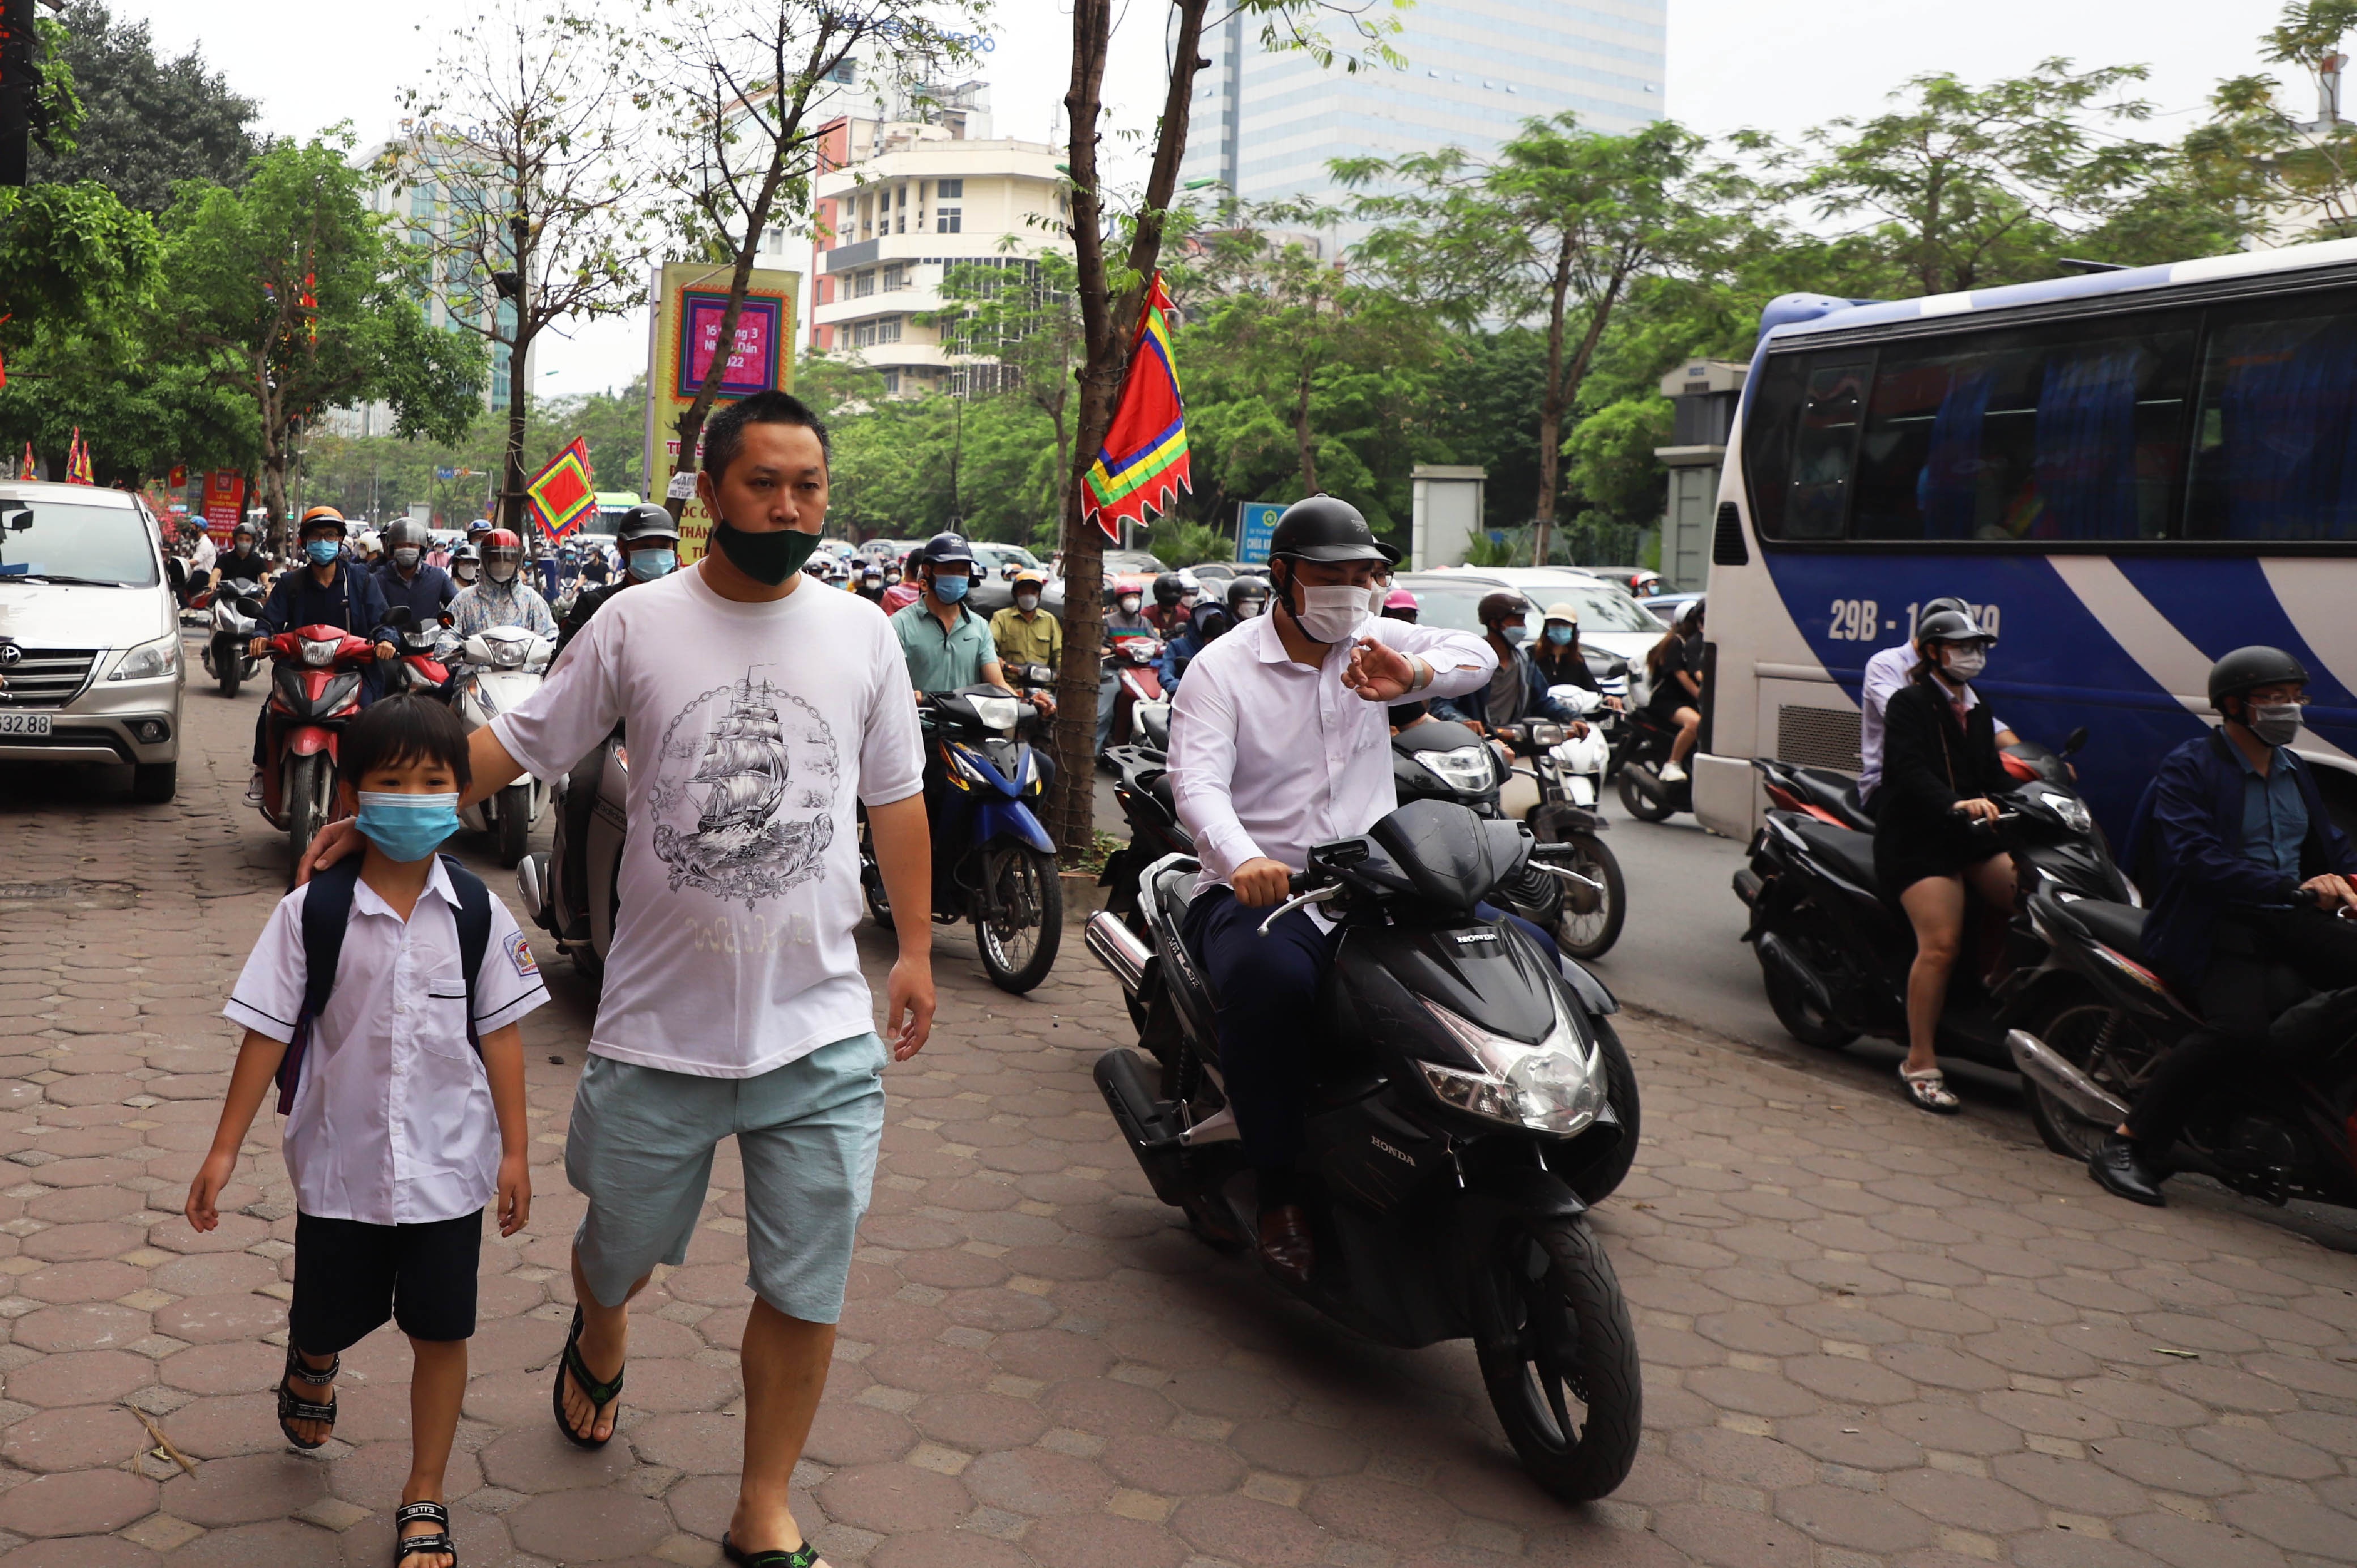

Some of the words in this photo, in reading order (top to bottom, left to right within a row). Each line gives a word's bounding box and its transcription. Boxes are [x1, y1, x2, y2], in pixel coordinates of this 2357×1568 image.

[705, 325, 717, 336] 16
[751, 327, 758, 339] 3
[1828, 599, 1878, 642] 29B
[0, 715, 48, 733] 32.88
[1456, 934, 1497, 943] HONDA
[1371, 1135, 1415, 1166] HONDA
